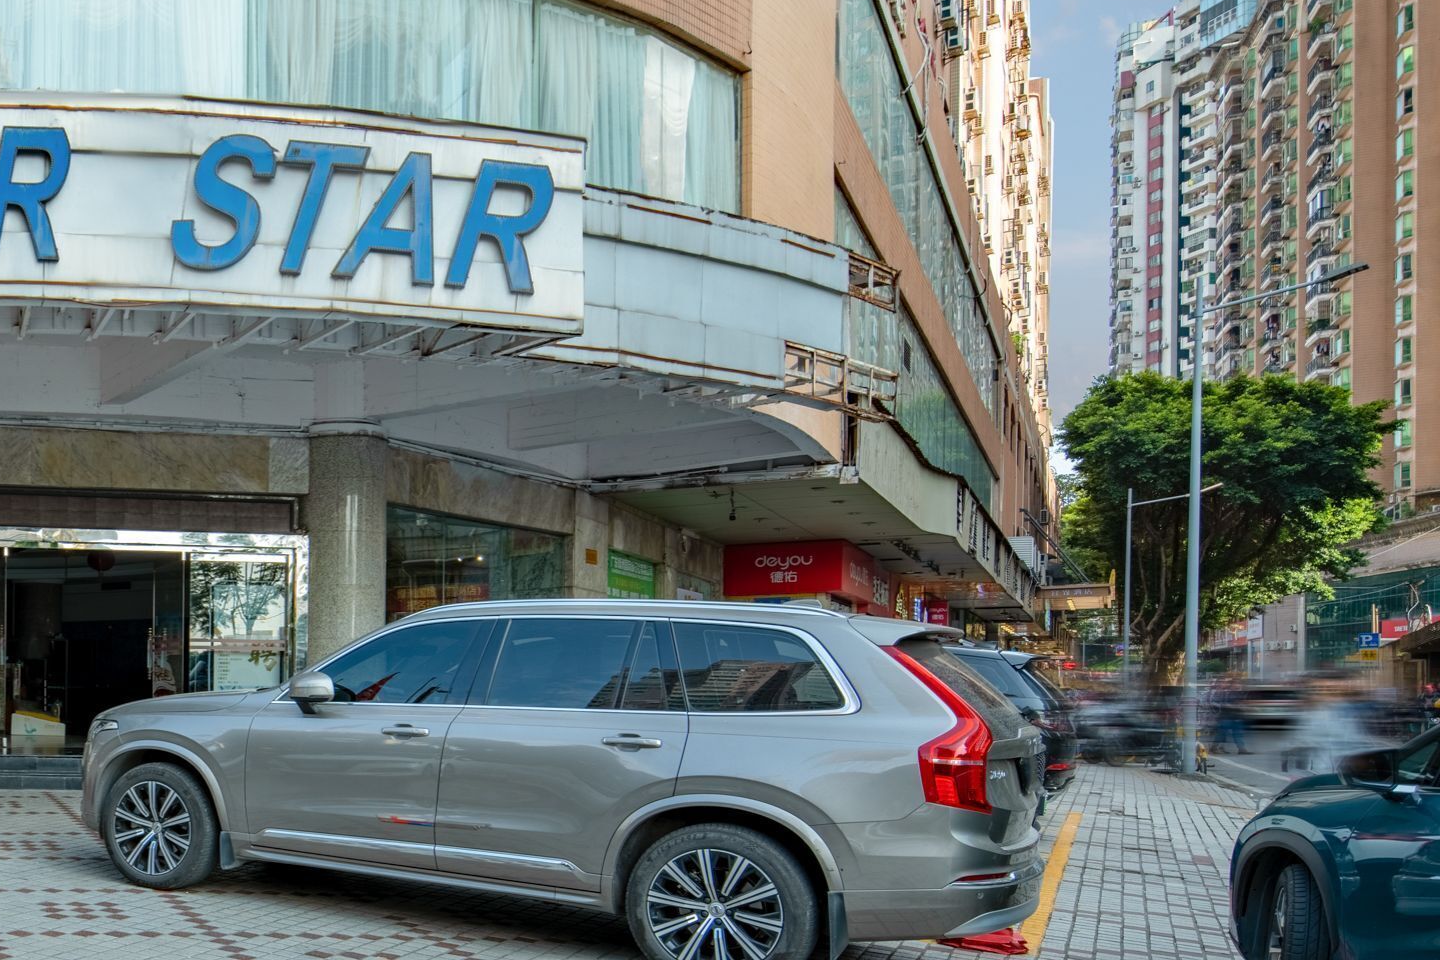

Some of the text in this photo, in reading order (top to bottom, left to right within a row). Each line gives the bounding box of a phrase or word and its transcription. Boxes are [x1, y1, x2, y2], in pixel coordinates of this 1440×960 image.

[171, 133, 554, 296] STAR
[755, 555, 813, 570] deyou
[770, 571, 798, 583] 德佑
[1360, 635, 1373, 646] P
